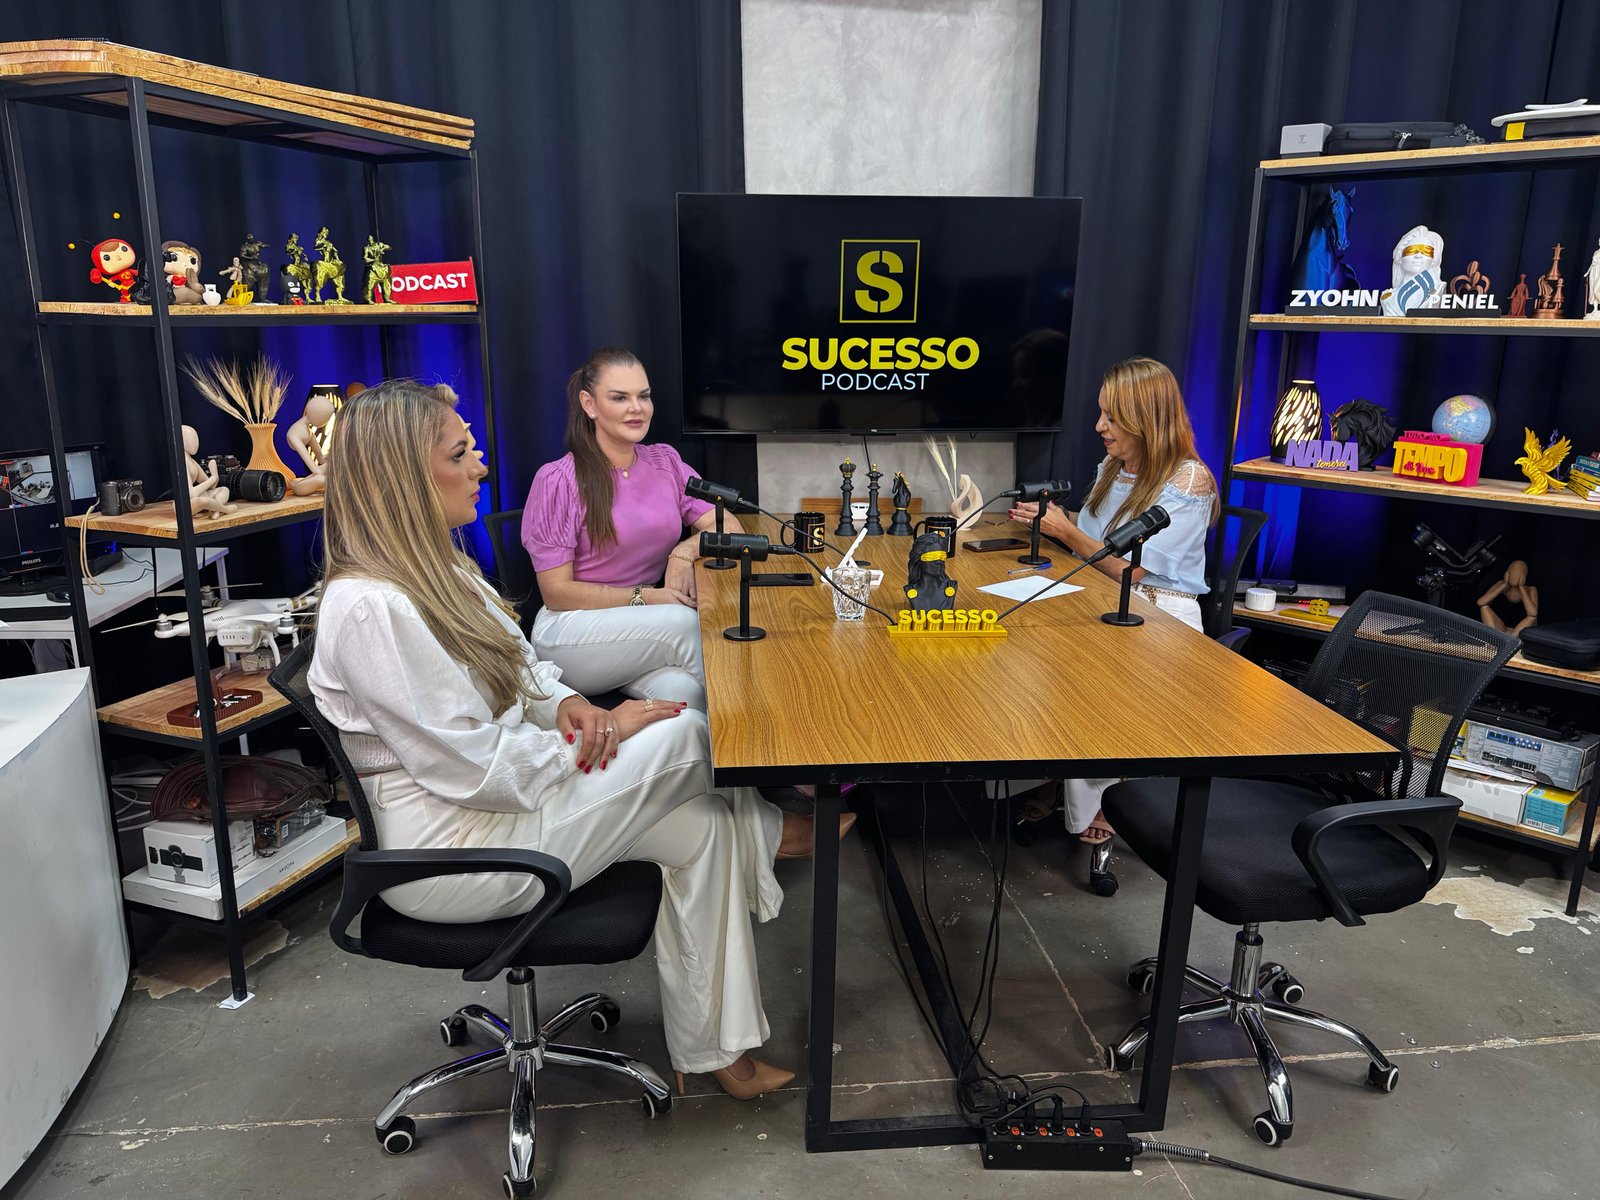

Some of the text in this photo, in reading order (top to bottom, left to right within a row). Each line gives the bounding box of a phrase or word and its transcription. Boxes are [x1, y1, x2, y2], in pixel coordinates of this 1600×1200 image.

[378, 273, 468, 293] ODCAST
[1289, 289, 1380, 307] ZYOHN
[1428, 293, 1499, 309] PENIEL
[781, 337, 980, 371] SUCESSO
[821, 373, 930, 391] PODCAST
[1285, 439, 1359, 472] NADA
[1392, 441, 1468, 482] TEMPO
[898, 609, 999, 625] SUCESSO
